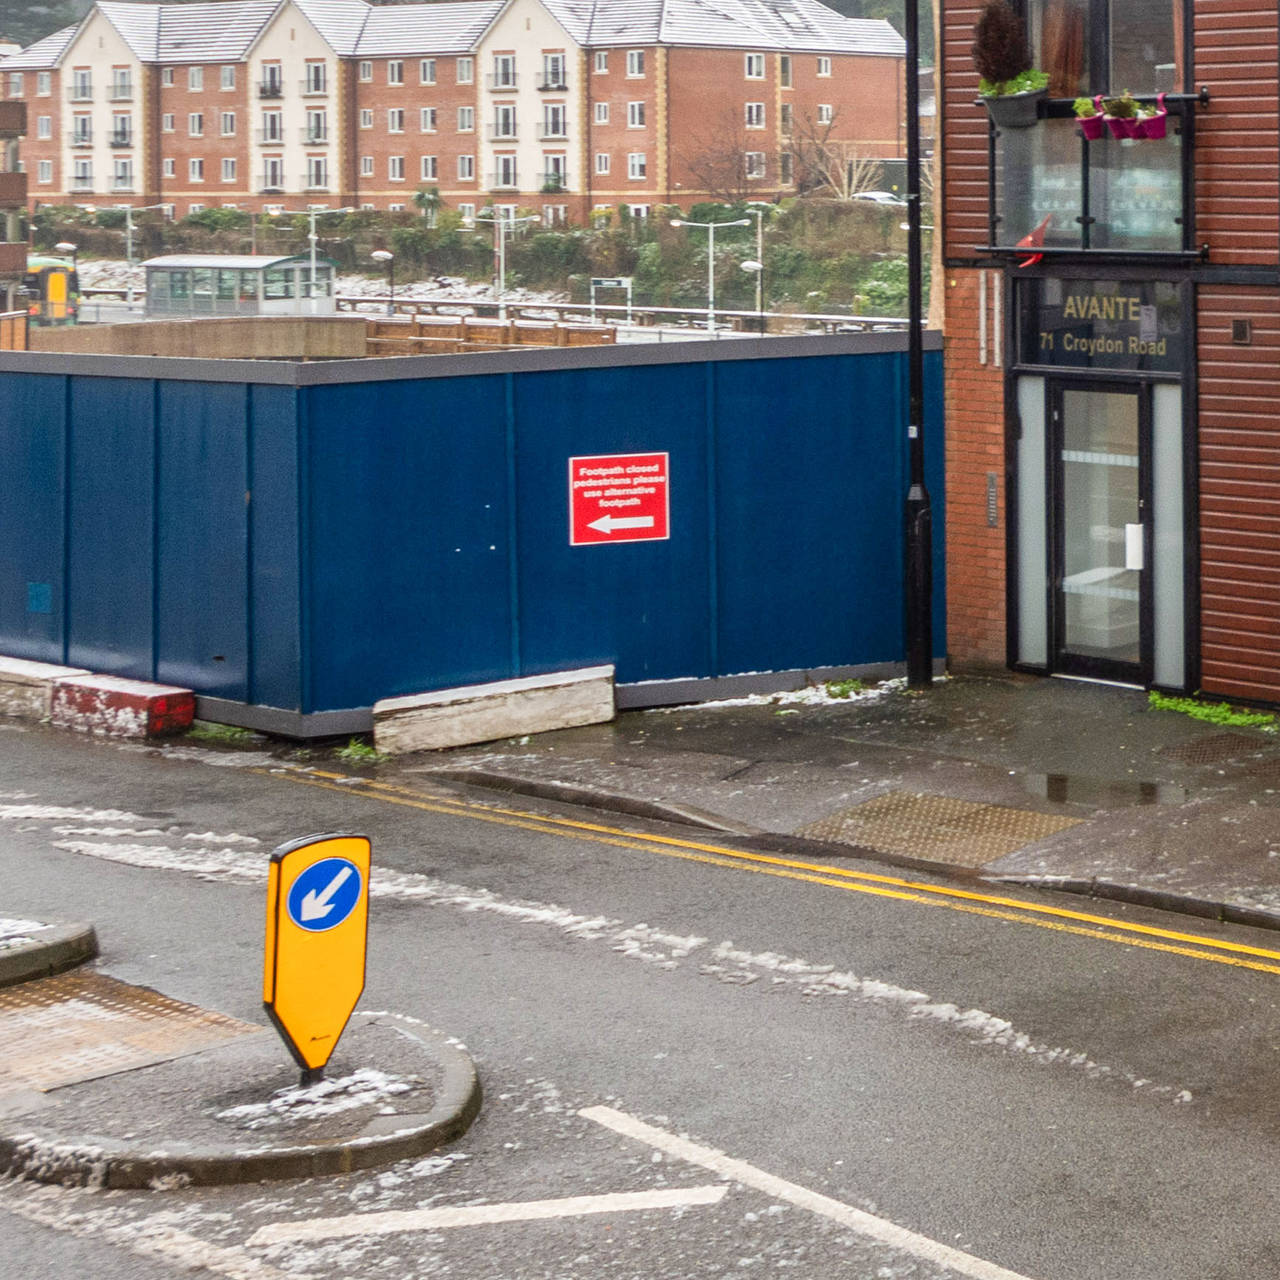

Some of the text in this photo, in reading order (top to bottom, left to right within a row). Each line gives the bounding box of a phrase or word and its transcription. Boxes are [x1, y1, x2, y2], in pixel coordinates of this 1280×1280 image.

[1063, 296, 1141, 321] AVANTE
[1040, 332, 1167, 357] 71 Croydon Road
[579, 464, 659, 476] Footpath closed
[573, 475, 665, 489] pedestrians please
[583, 486, 656, 498] use alternative
[598, 497, 641, 508] footpath
